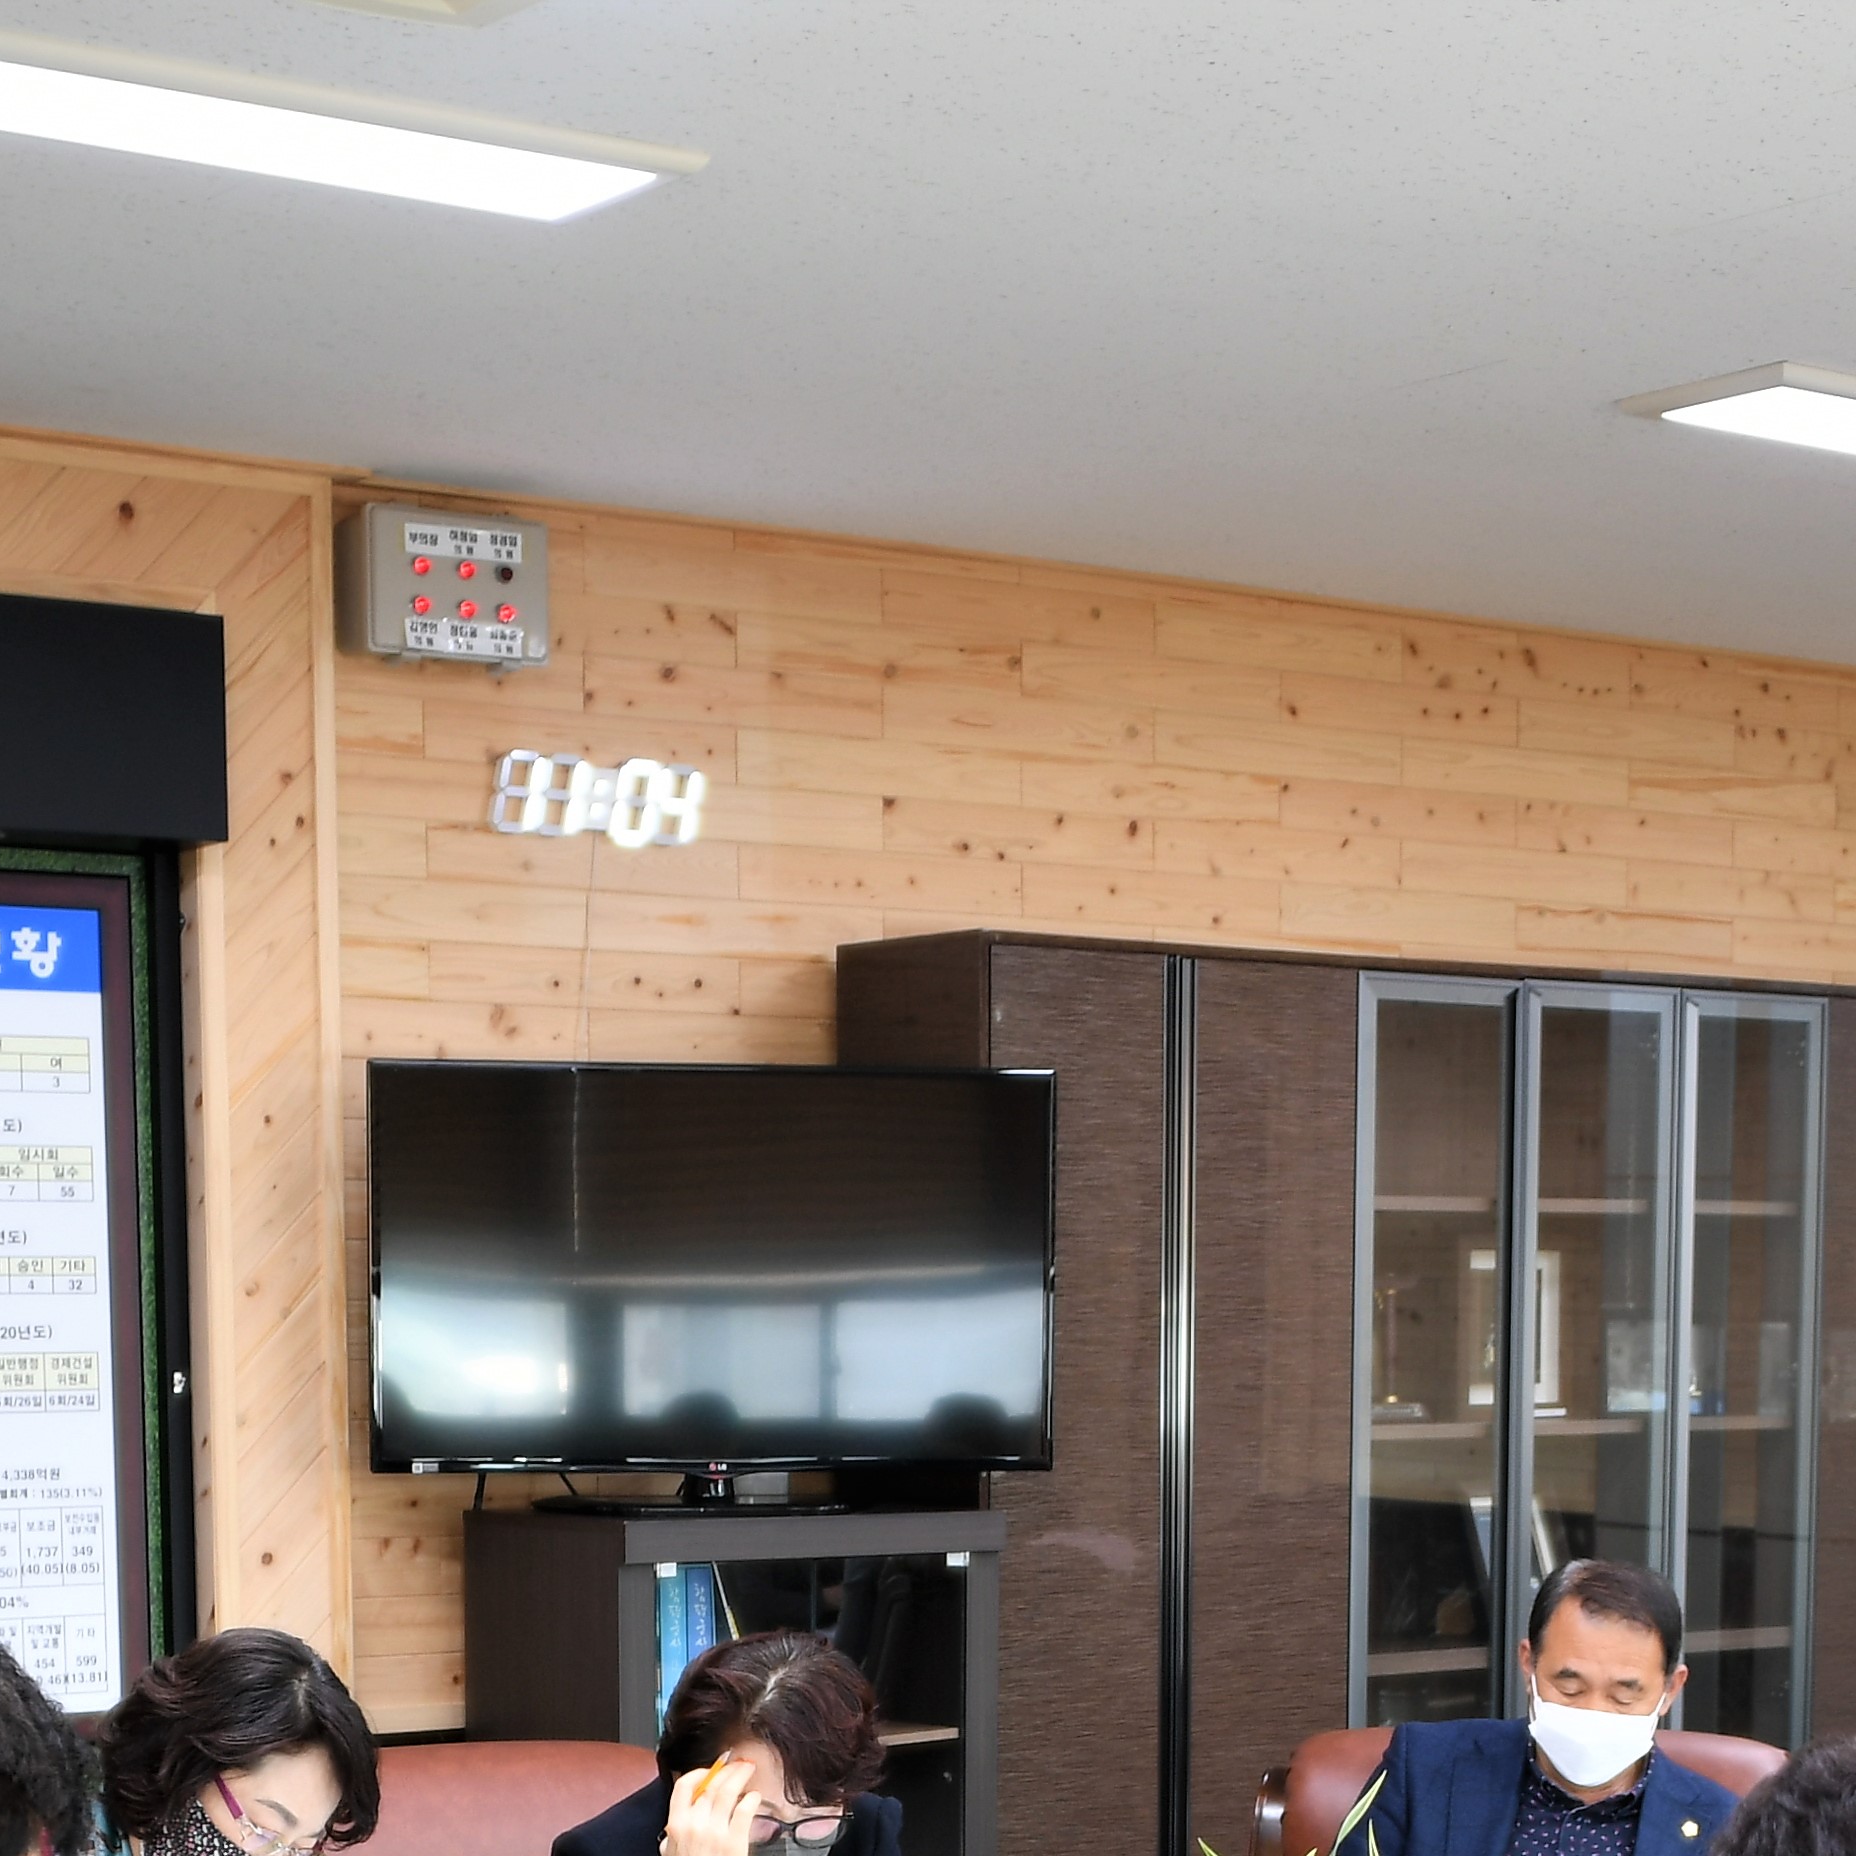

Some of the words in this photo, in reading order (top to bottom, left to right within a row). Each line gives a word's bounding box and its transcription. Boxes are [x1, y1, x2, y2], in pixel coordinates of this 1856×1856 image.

[522, 754, 706, 848] 11:04
[52, 1076, 60, 1088] 3
[9, 1184, 15, 1196] 7
[27, 1279, 34, 1290] 4
[68, 1279, 83, 1290] 32
[72, 1546, 93, 1556] 349
